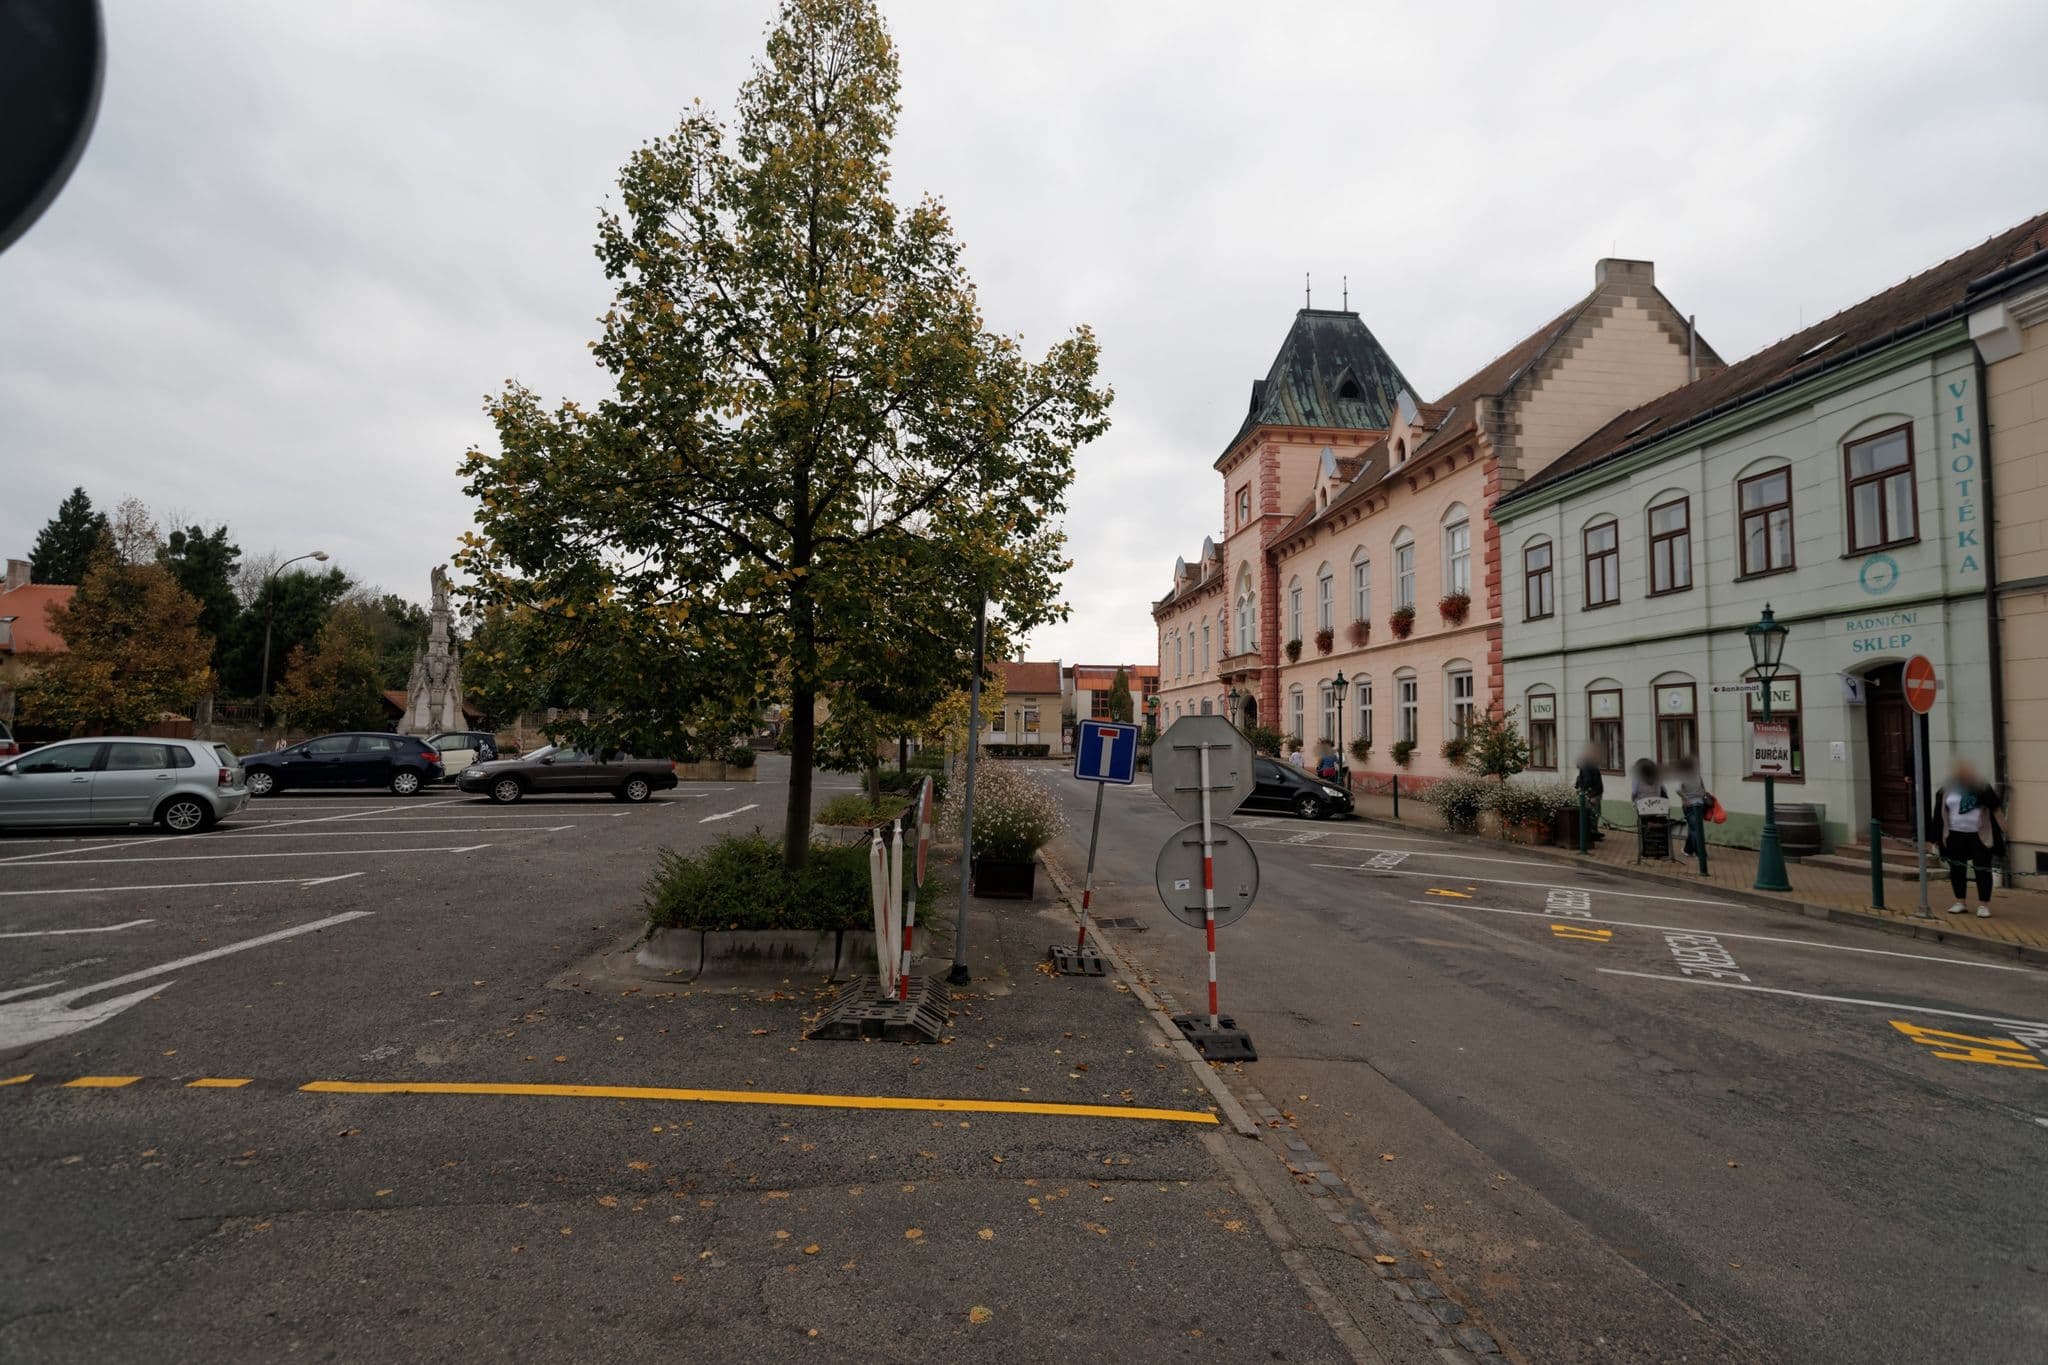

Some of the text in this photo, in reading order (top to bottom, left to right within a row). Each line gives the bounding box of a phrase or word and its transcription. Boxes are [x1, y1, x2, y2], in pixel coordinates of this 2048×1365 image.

[1948, 379, 1979, 573] VINOTÉKA
[1846, 611, 1917, 631] RADNIČNÍ
[1852, 634, 1912, 653] SKLEP
[1721, 684, 1760, 692] Bankomat
[1756, 690, 1792, 702] WNE
[1755, 747, 1788, 760] BURČÁK
[1662, 932, 1752, 982] RESERVE
